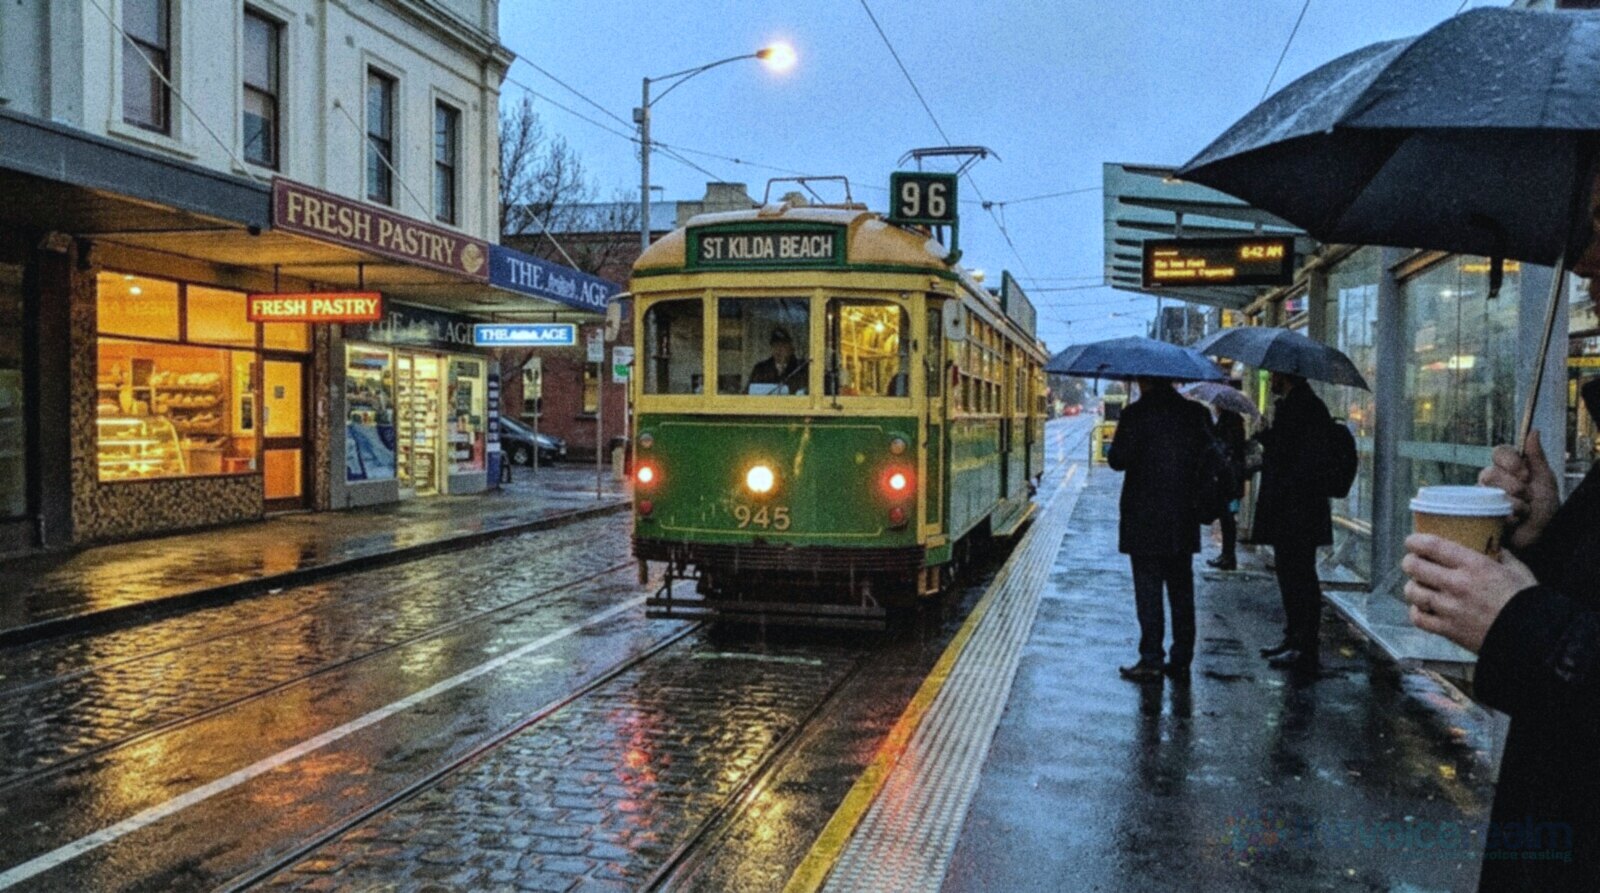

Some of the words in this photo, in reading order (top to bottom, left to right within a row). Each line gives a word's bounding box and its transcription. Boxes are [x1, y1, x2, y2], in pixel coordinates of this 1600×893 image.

[901, 182, 947, 218] 96
[287, 191, 371, 242] FRESH
[379, 217, 456, 265] PASTRY
[703, 236, 723, 259] ST
[728, 235, 775, 259] KILDA
[780, 234, 833, 258] BEACH
[1266, 245, 1284, 257] AM
[507, 256, 544, 290] THE
[580, 281, 609, 308] AGE
[251, 299, 307, 316] FRESH
[311, 299, 378, 316] PASTRY
[480, 328, 508, 340] THE
[734, 505, 790, 531] 945
